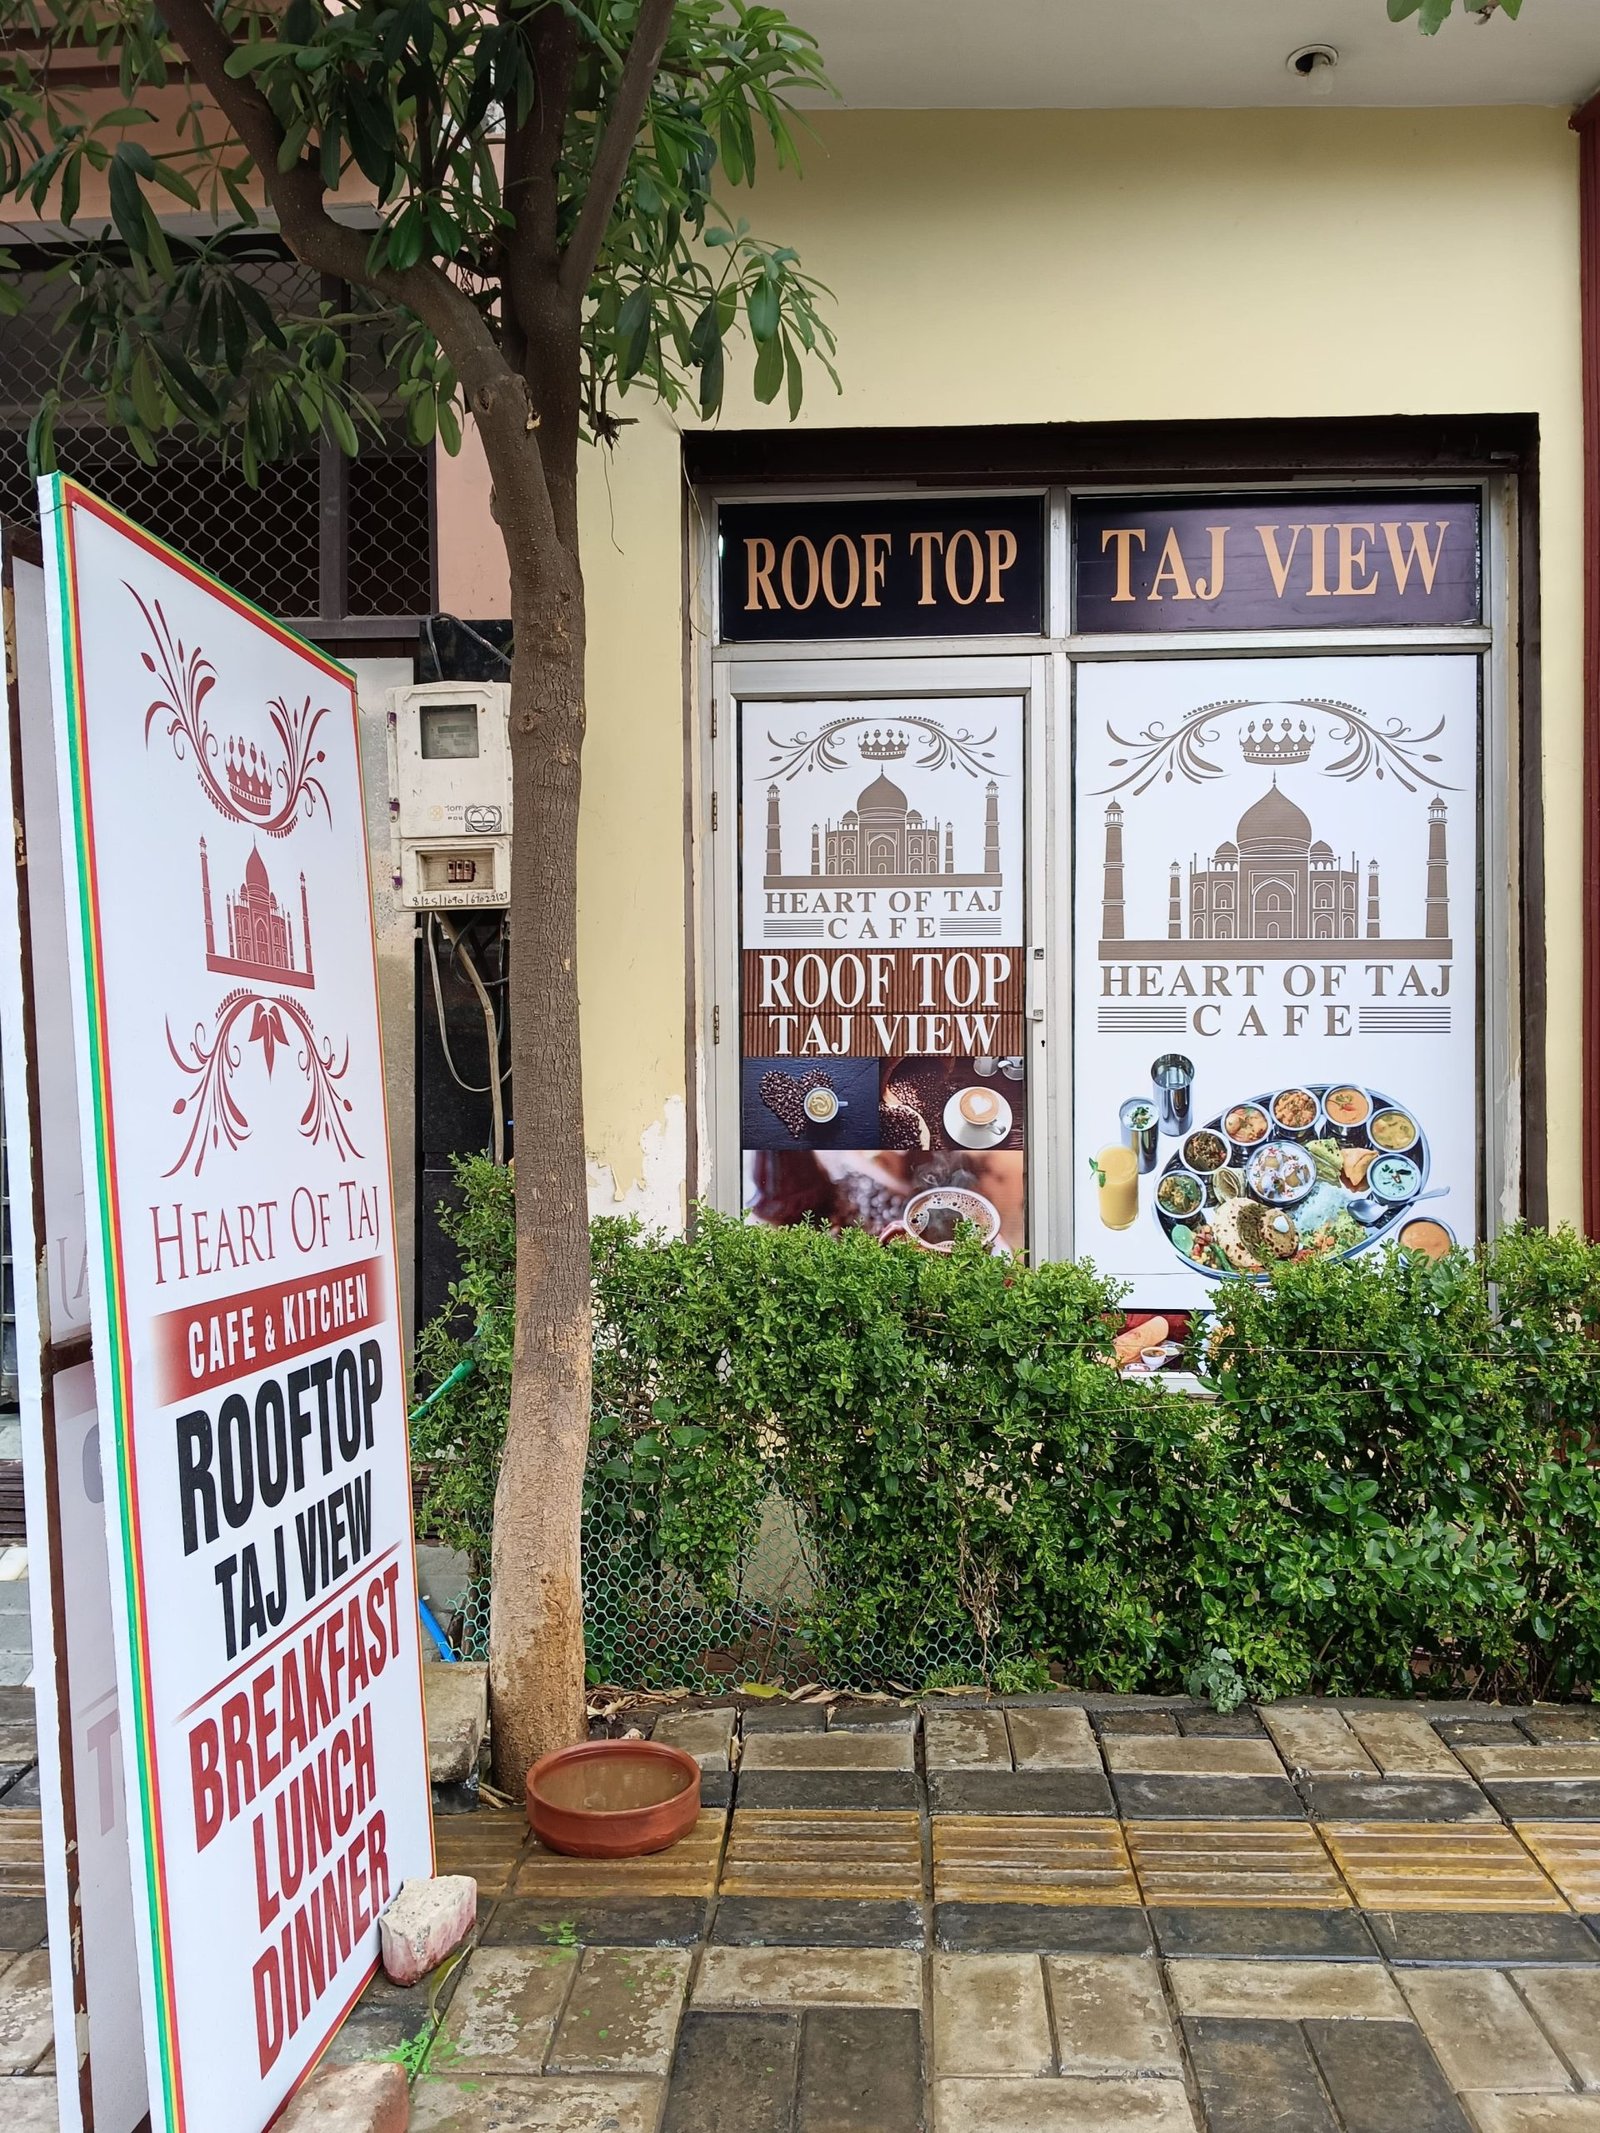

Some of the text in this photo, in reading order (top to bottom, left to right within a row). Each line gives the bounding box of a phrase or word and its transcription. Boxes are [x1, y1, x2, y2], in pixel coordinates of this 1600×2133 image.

[743, 529, 1018, 611] ROOF TOP
[1101, 521, 1450, 602] TAJ VIEW
[765, 890, 1003, 914] HEART OF TAJ
[827, 917, 936, 940] CAFE
[758, 952, 1011, 1009] ROOF TOP
[1099, 964, 1454, 998] HEART OF TAJ
[1192, 1004, 1353, 1037] CAFE
[769, 1014, 1001, 1056] TAJ VIEW
[148, 1200, 278, 1285] HEART
[290, 1186, 331, 1253] OF
[338, 1180, 381, 1251] TAJ
[188, 1273, 369, 1379] CAFE & KITCHEN
[176, 1338, 383, 1557] ROOFTOP
[214, 1469, 371, 1662] TAJ VIEW
[188, 1561, 400, 1854] BREAKFAST
[252, 1702, 377, 1934] LUNCH
[252, 1809, 391, 2081] DINNER
